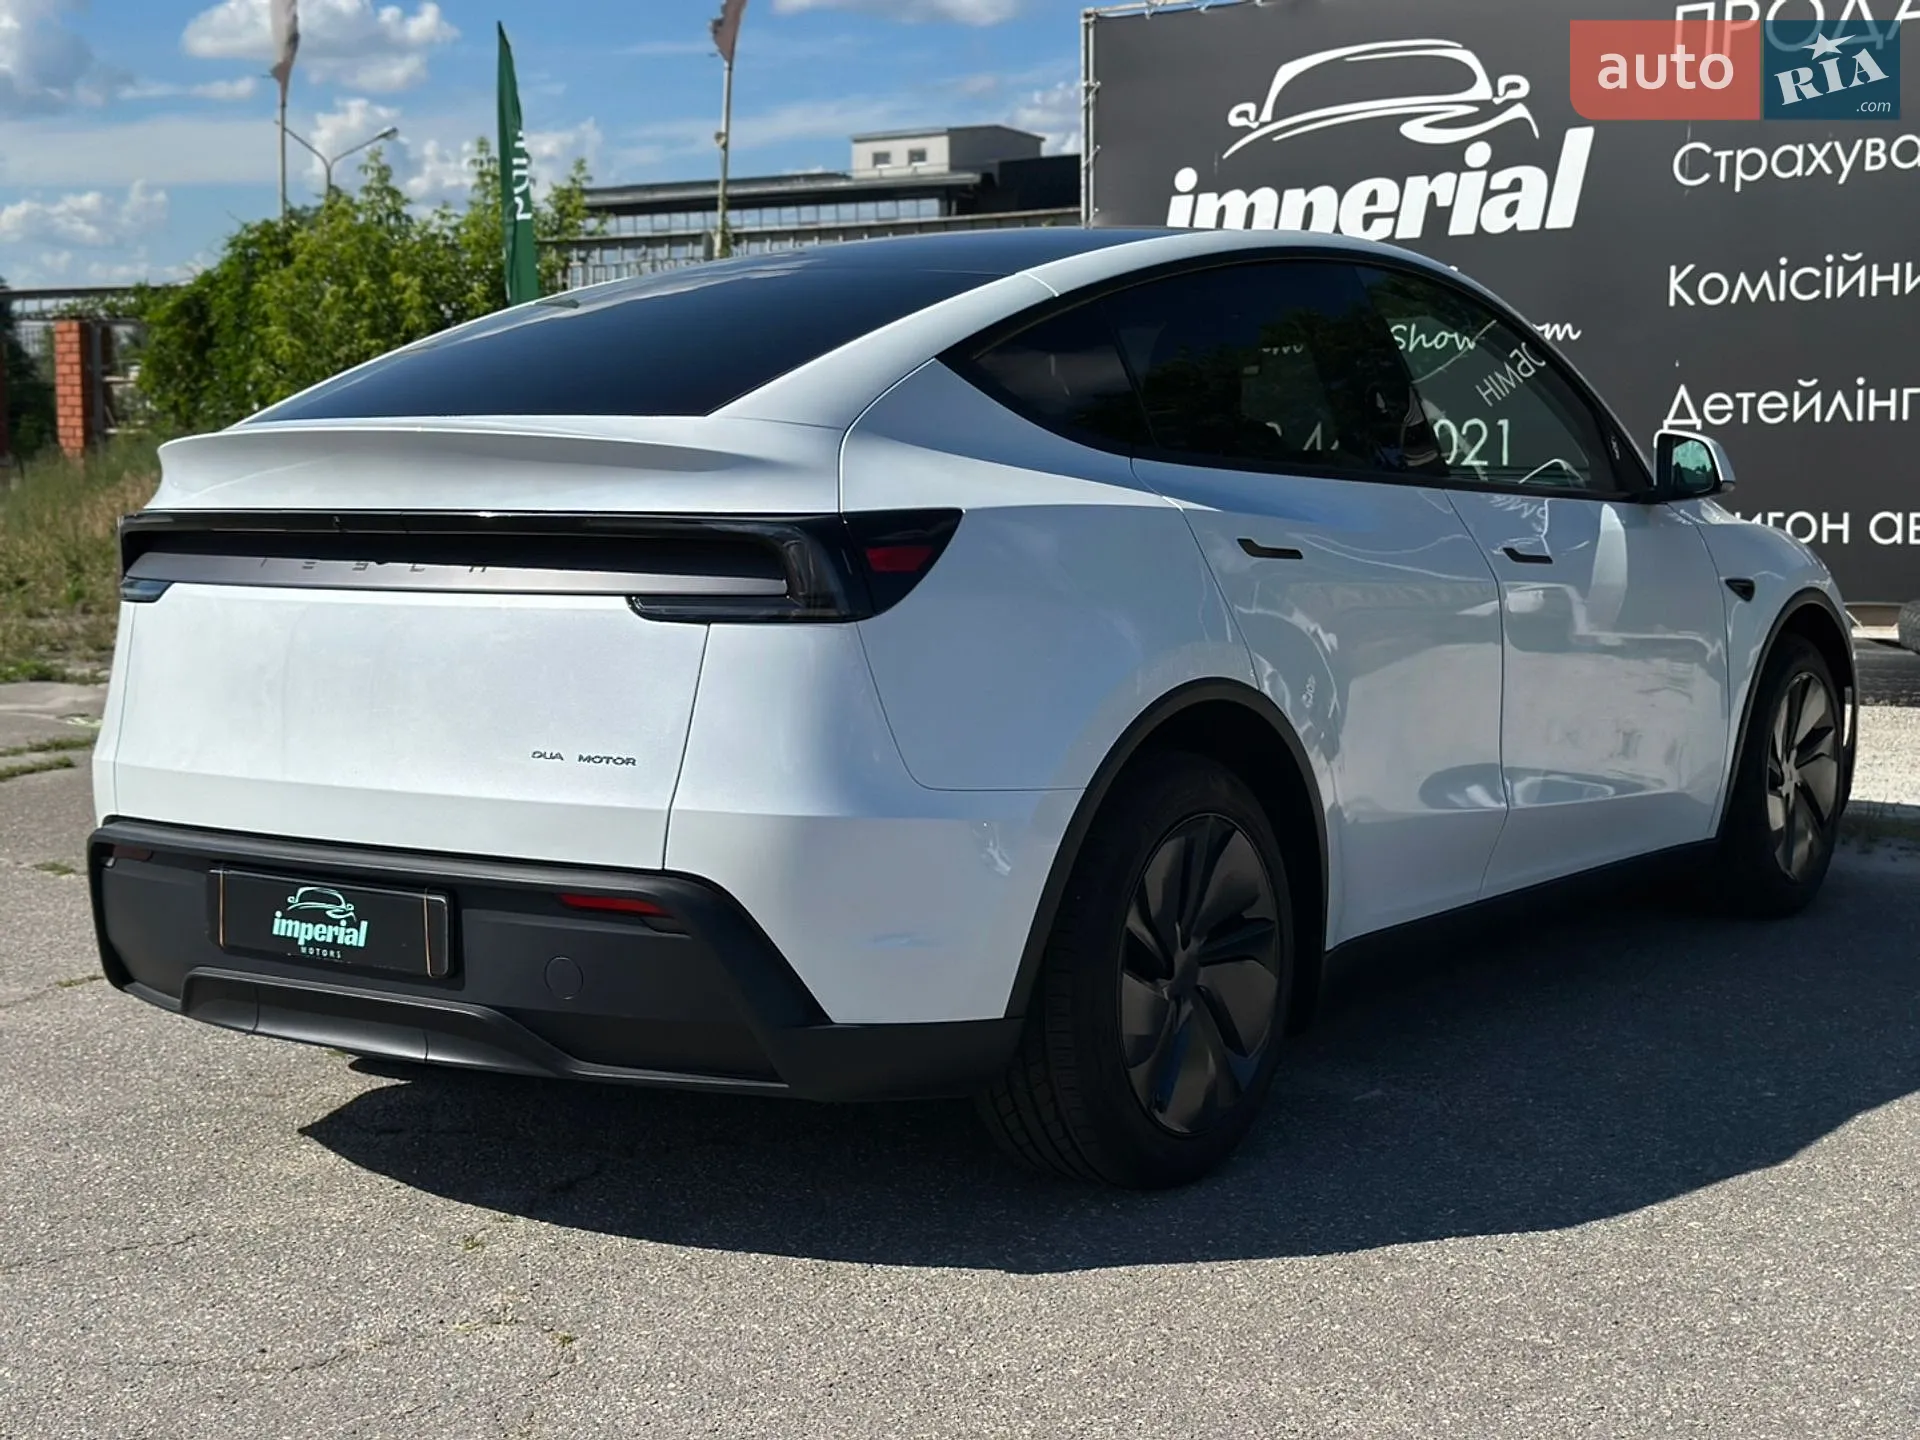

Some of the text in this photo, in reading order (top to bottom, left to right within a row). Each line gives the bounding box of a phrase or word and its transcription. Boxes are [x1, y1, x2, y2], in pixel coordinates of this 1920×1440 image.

[1166, 126, 1595, 242] imperial
[577, 753, 638, 767] MOTOR
[272, 910, 369, 948] imperial
[300, 946, 342, 960] MOTORS
